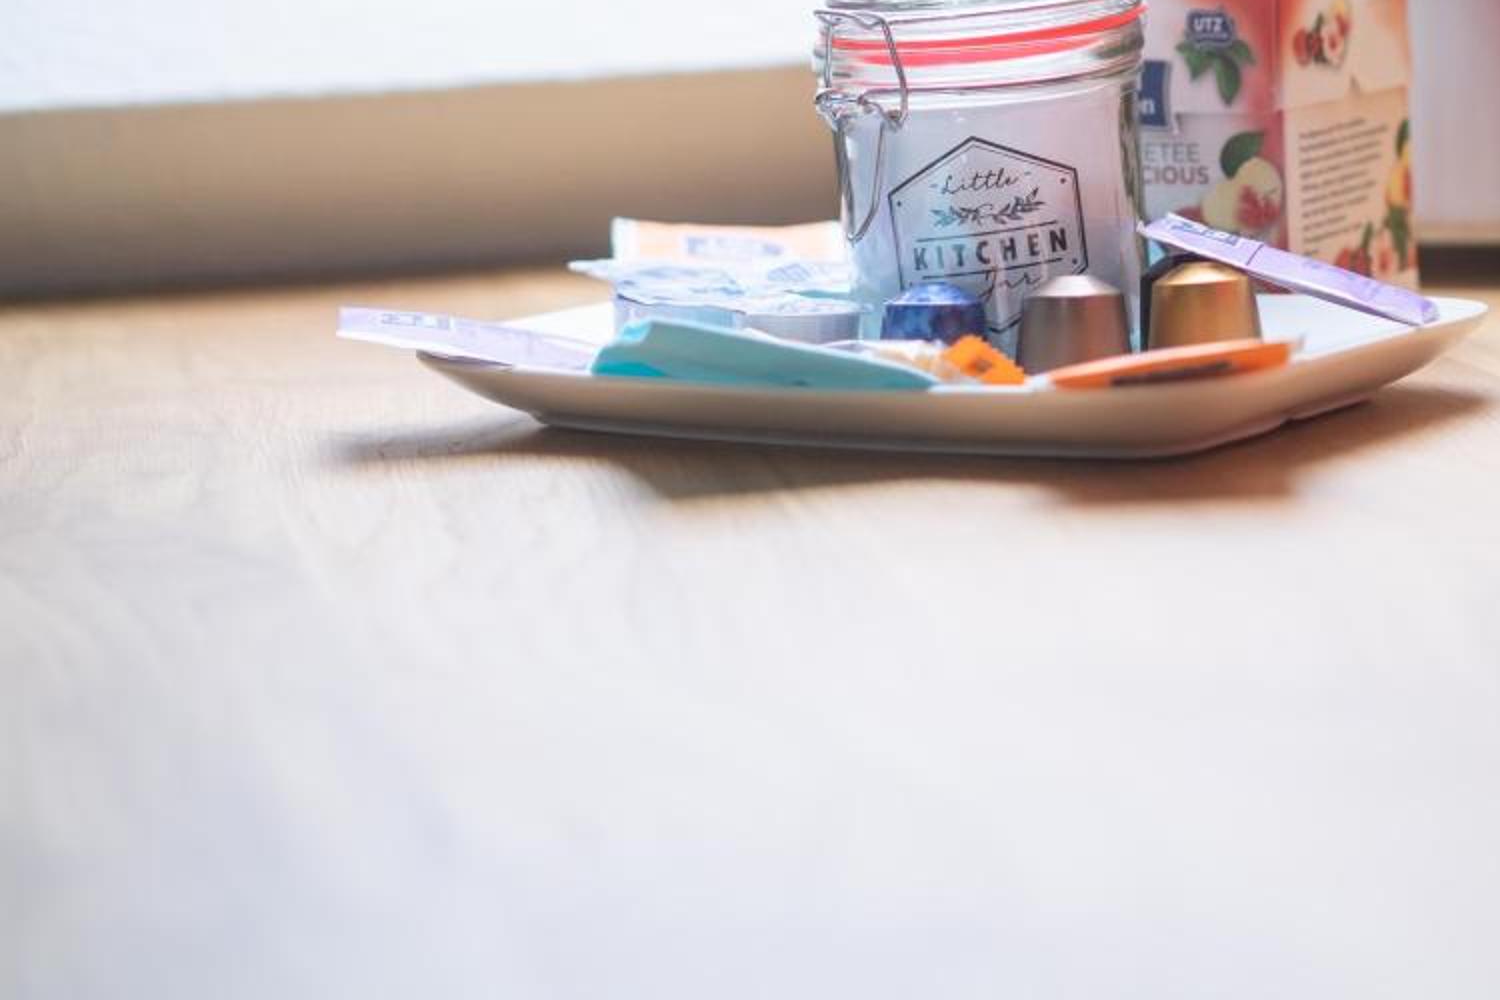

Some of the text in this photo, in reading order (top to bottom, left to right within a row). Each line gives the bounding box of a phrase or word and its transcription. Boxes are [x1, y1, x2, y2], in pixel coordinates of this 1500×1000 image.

[1193, 17, 1223, 32] UTZ
[1143, 143, 1200, 162] ETEE
[942, 168, 1019, 194] Little
[1142, 165, 1209, 185] CIOUS
[913, 229, 1068, 271] KITCHEN
